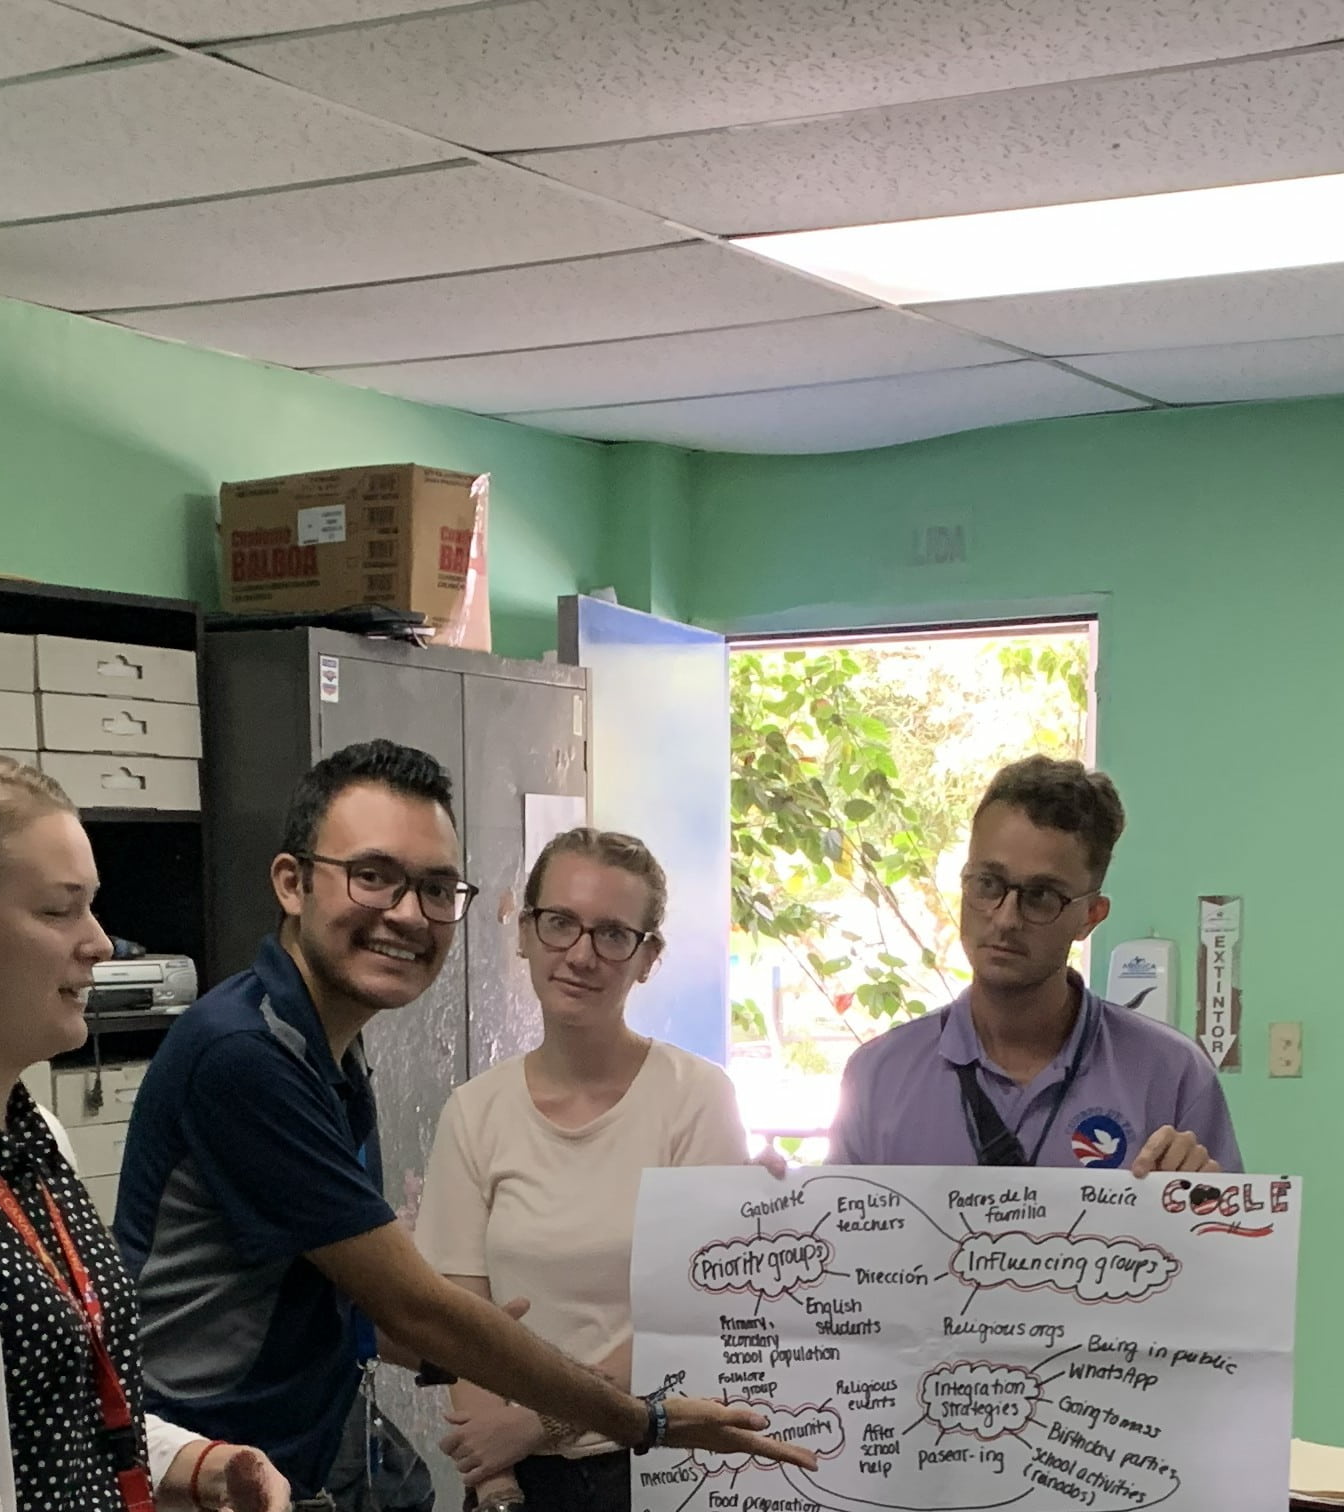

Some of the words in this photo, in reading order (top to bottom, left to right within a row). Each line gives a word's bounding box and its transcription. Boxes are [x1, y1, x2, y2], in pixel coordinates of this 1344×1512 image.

[1211, 935, 1225, 1053] EXTINTOR
[740, 1189, 805, 1218] Gabinete
[837, 1192, 900, 1216] English
[1000, 1188, 1019, 1203] de
[1023, 1186, 1037, 1201] la
[837, 1215, 905, 1232] teachers
[986, 1203, 1047, 1223] familia
[702, 1253, 764, 1280] Priority
[766, 1242, 824, 1280] groups
[968, 1250, 1089, 1284] Influencing
[1095, 1257, 1159, 1284] groups
[856, 1264, 928, 1285] Dirección
[806, 1297, 862, 1320] English
[816, 1318, 882, 1335] students
[943, 1317, 1026, 1343] Religious
[1029, 1323, 1066, 1348] orgs
[720, 1333, 779, 1350] secondary
[722, 1351, 762, 1365] school
[770, 1345, 841, 1367] population
[1087, 1334, 1138, 1363] Being
[1148, 1341, 1168, 1356] in
[1172, 1346, 1239, 1376] public
[1068, 1362, 1159, 1391] WhatsApp
[742, 1382, 778, 1399] group
[836, 1379, 898, 1400] Religious
[935, 1379, 1026, 1403] Integration
[848, 1397, 896, 1411] events
[1058, 1394, 1101, 1430] Going
[1102, 1408, 1119, 1426] to
[1118, 1415, 1162, 1439] mass
[863, 1425, 896, 1441] After
[861, 1441, 900, 1455] school
[1047, 1421, 1116, 1462] Birthday
[1120, 1451, 1181, 1480] parties
[859, 1461, 892, 1477] help
[1031, 1446, 1075, 1476] school
[1074, 1465, 1148, 1504] activities
[709, 1492, 738, 1508] Food
